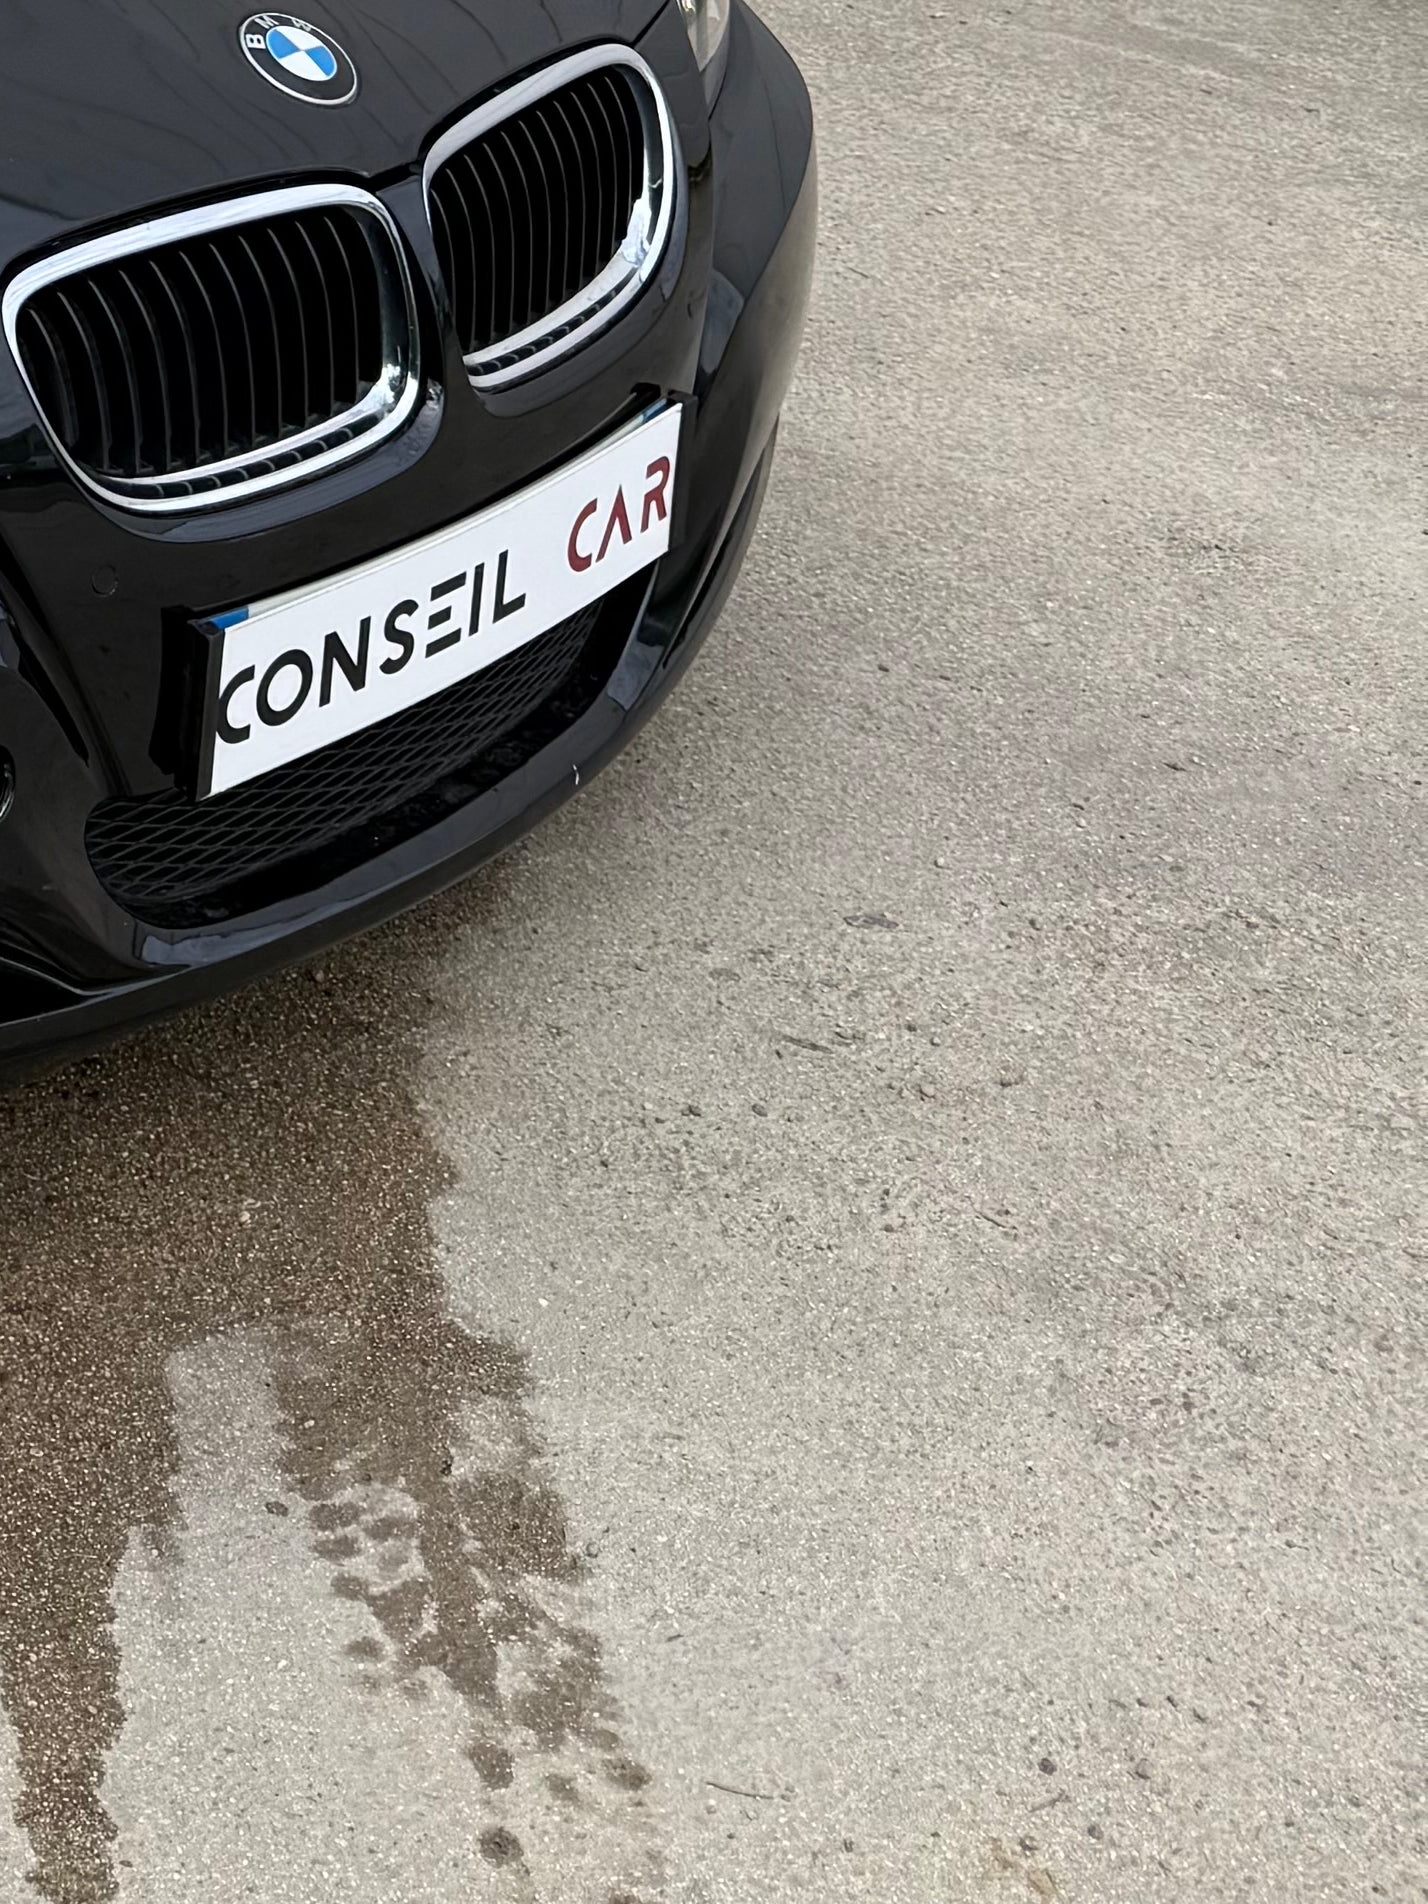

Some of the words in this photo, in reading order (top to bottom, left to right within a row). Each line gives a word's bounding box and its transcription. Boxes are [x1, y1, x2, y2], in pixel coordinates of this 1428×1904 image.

[246, 15, 312, 49] BMW
[216, 549, 526, 744] CONSEIL
[567, 455, 671, 573] CAR
